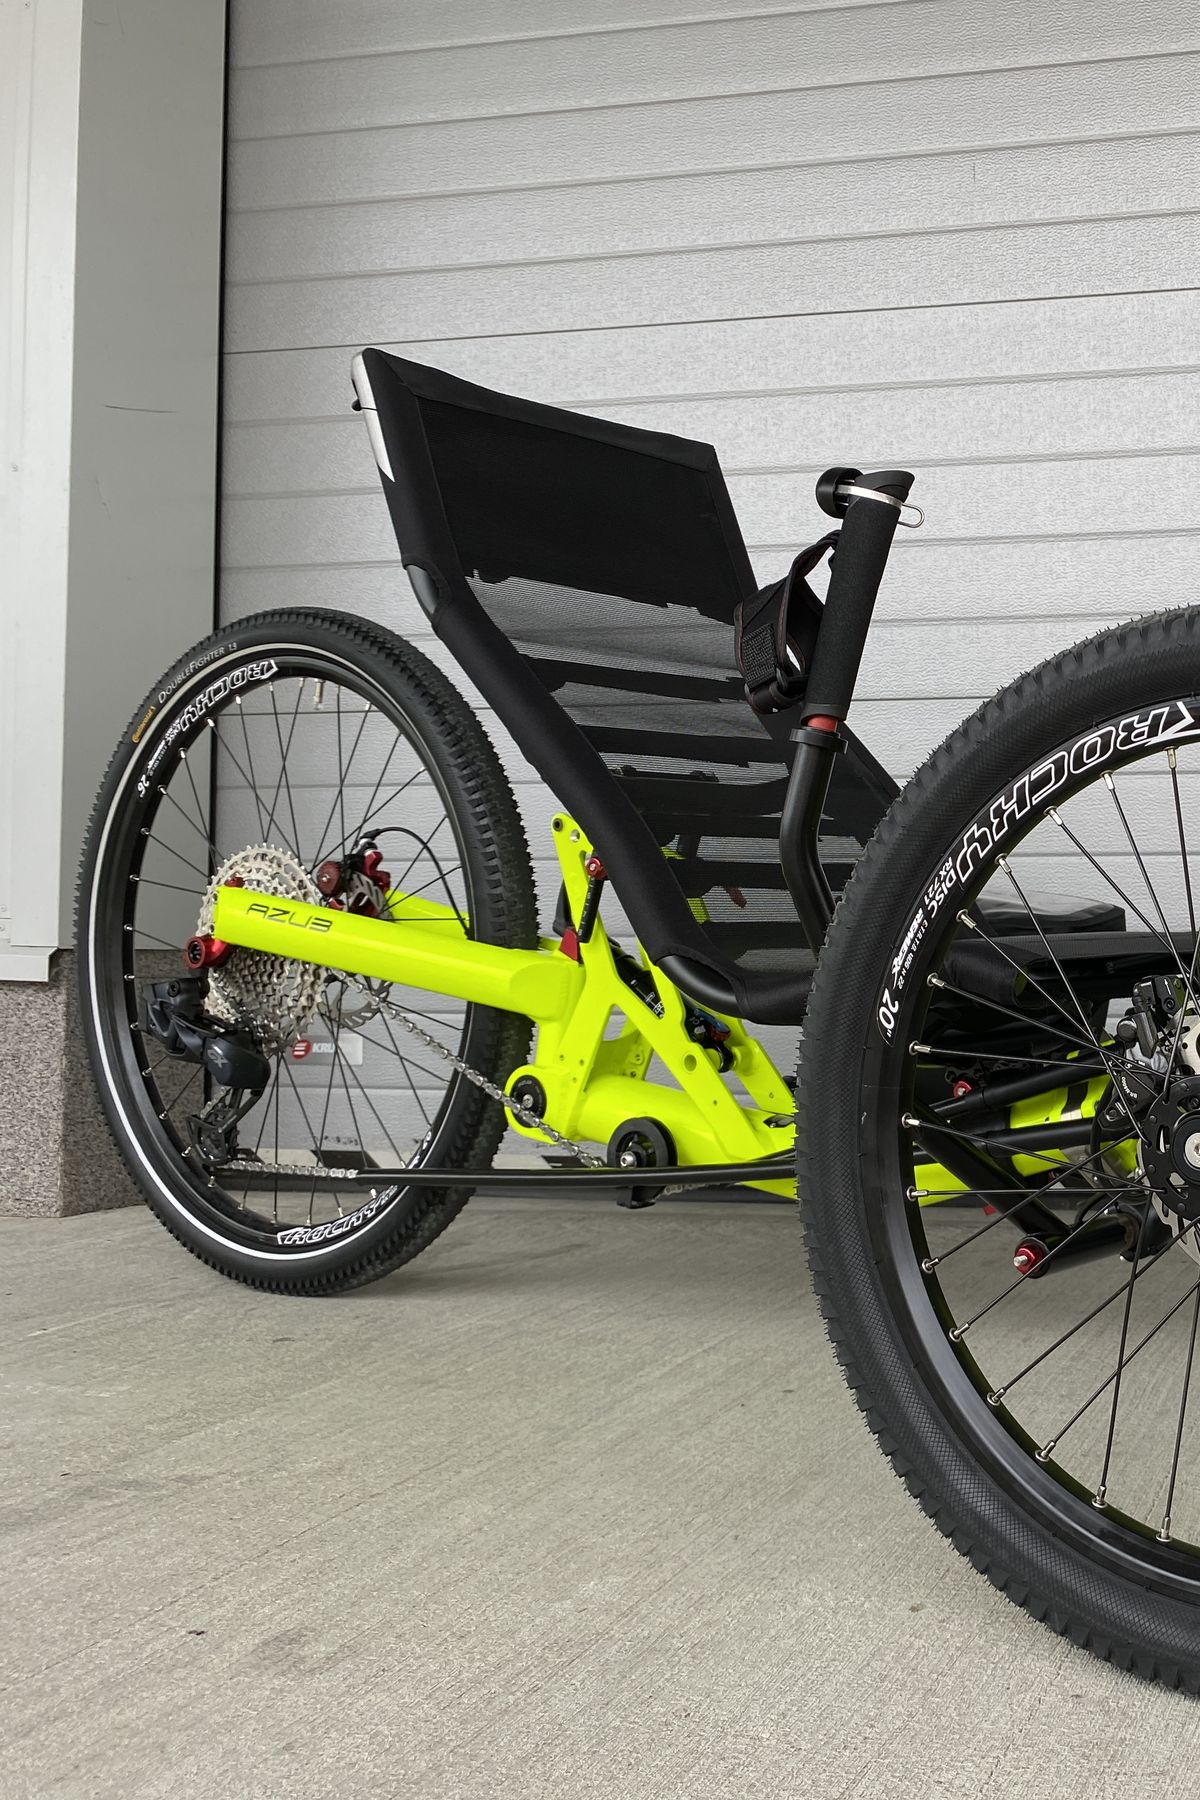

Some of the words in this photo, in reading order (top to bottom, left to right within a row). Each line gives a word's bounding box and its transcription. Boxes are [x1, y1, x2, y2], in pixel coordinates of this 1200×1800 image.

[956, 704, 1174, 883] ROCKY
[924, 880, 940, 905] 721
[927, 868, 957, 919] DISC
